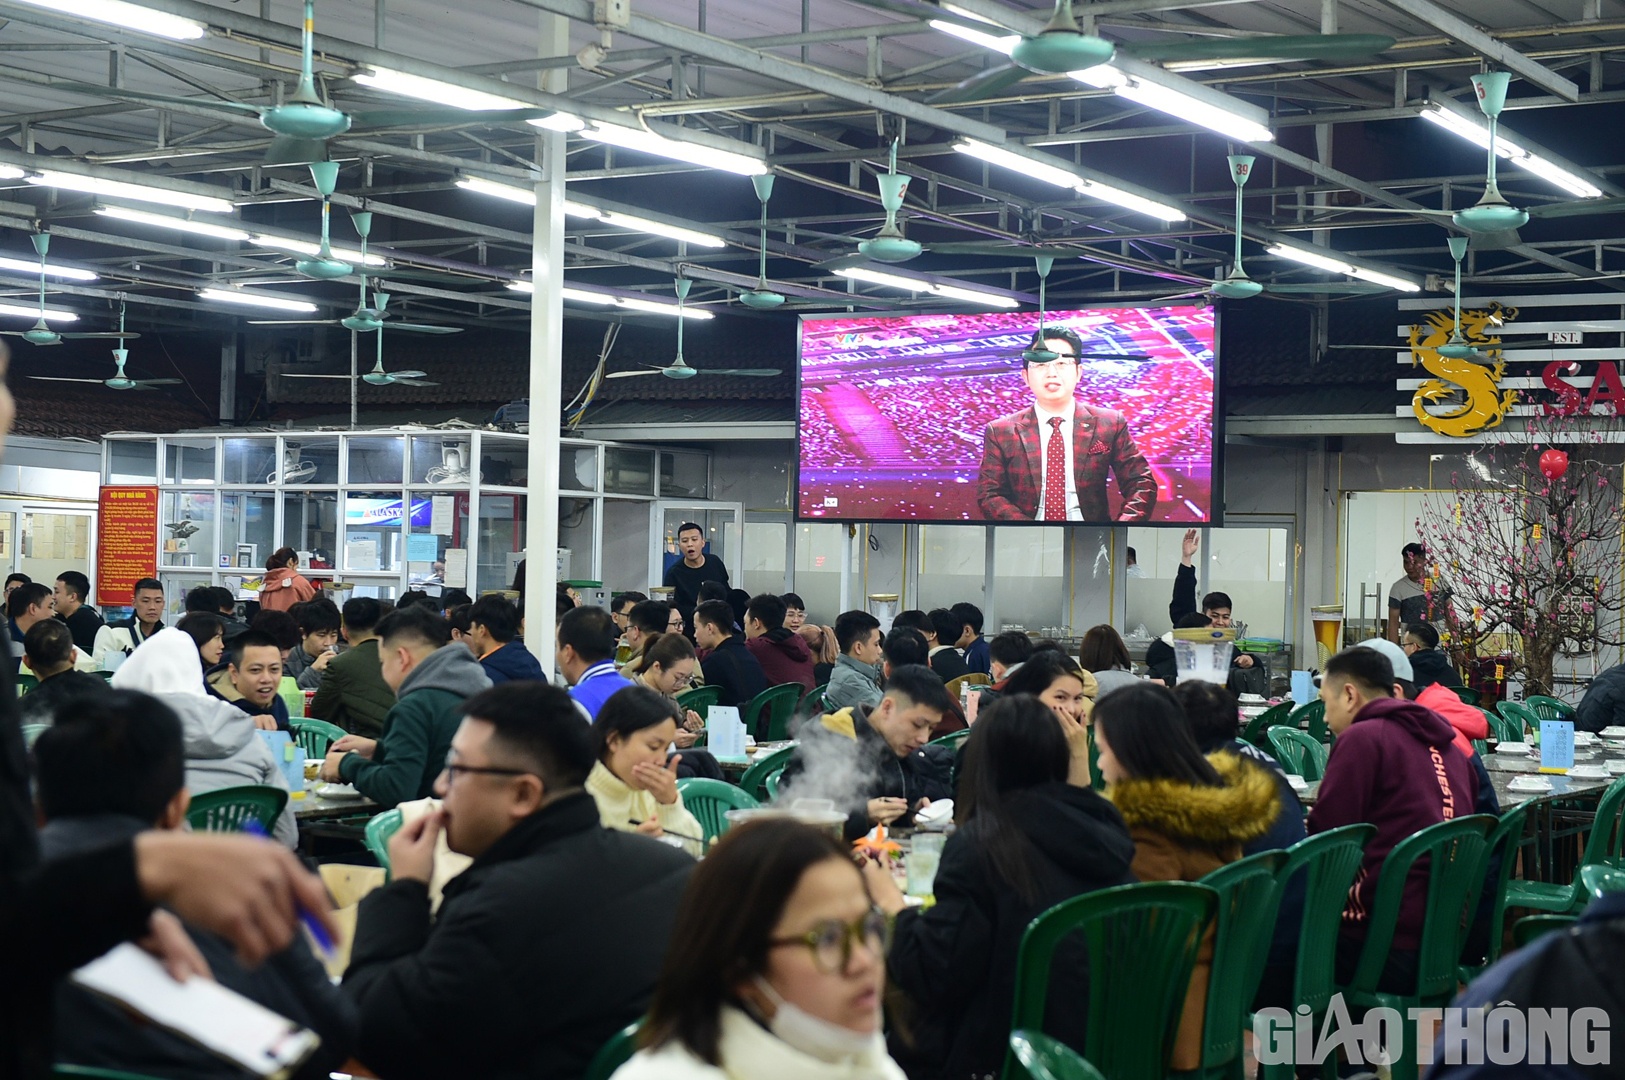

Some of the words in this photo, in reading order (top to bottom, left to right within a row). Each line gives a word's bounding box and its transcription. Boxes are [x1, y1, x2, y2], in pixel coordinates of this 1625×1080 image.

[1236, 163, 1249, 176] 39
[1552, 332, 1579, 343] EST.
[1429, 746, 1455, 822] CHESTE
